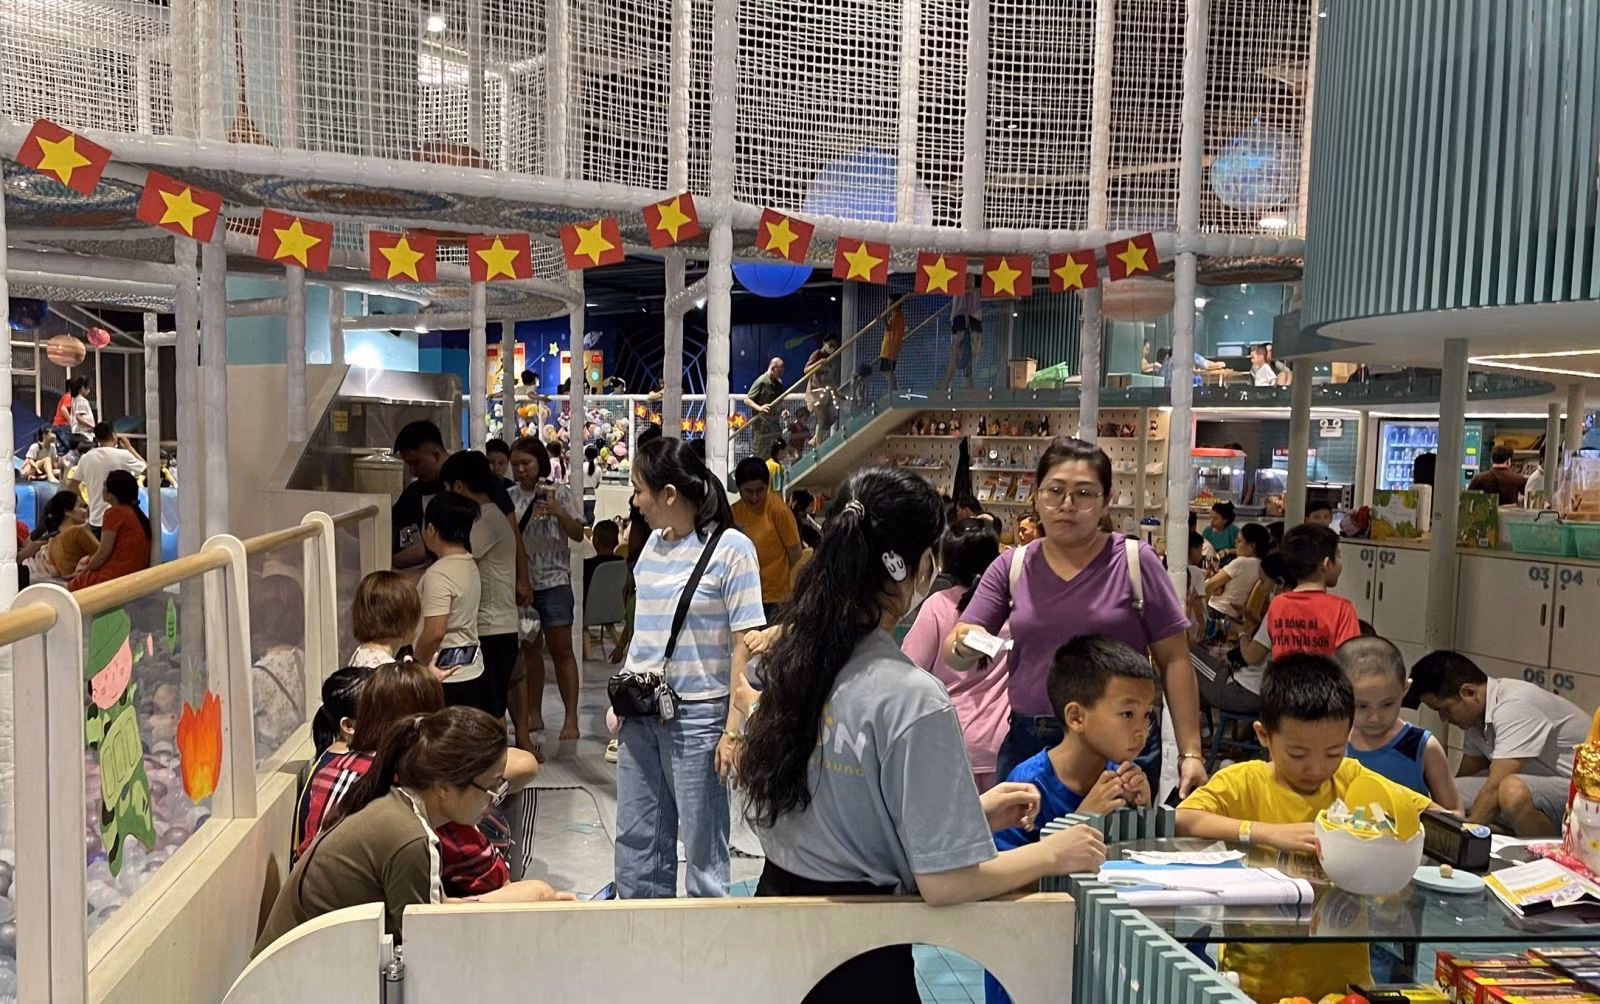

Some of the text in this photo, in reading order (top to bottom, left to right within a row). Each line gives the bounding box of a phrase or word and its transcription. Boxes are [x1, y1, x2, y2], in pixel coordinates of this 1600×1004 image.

[1360, 548, 1374, 562] 01
[1379, 550, 1396, 565] 02
[1528, 566, 1550, 582] 03
[1560, 569, 1584, 586] 04
[1523, 667, 1545, 685] 06
[1553, 672, 1574, 691] 05
